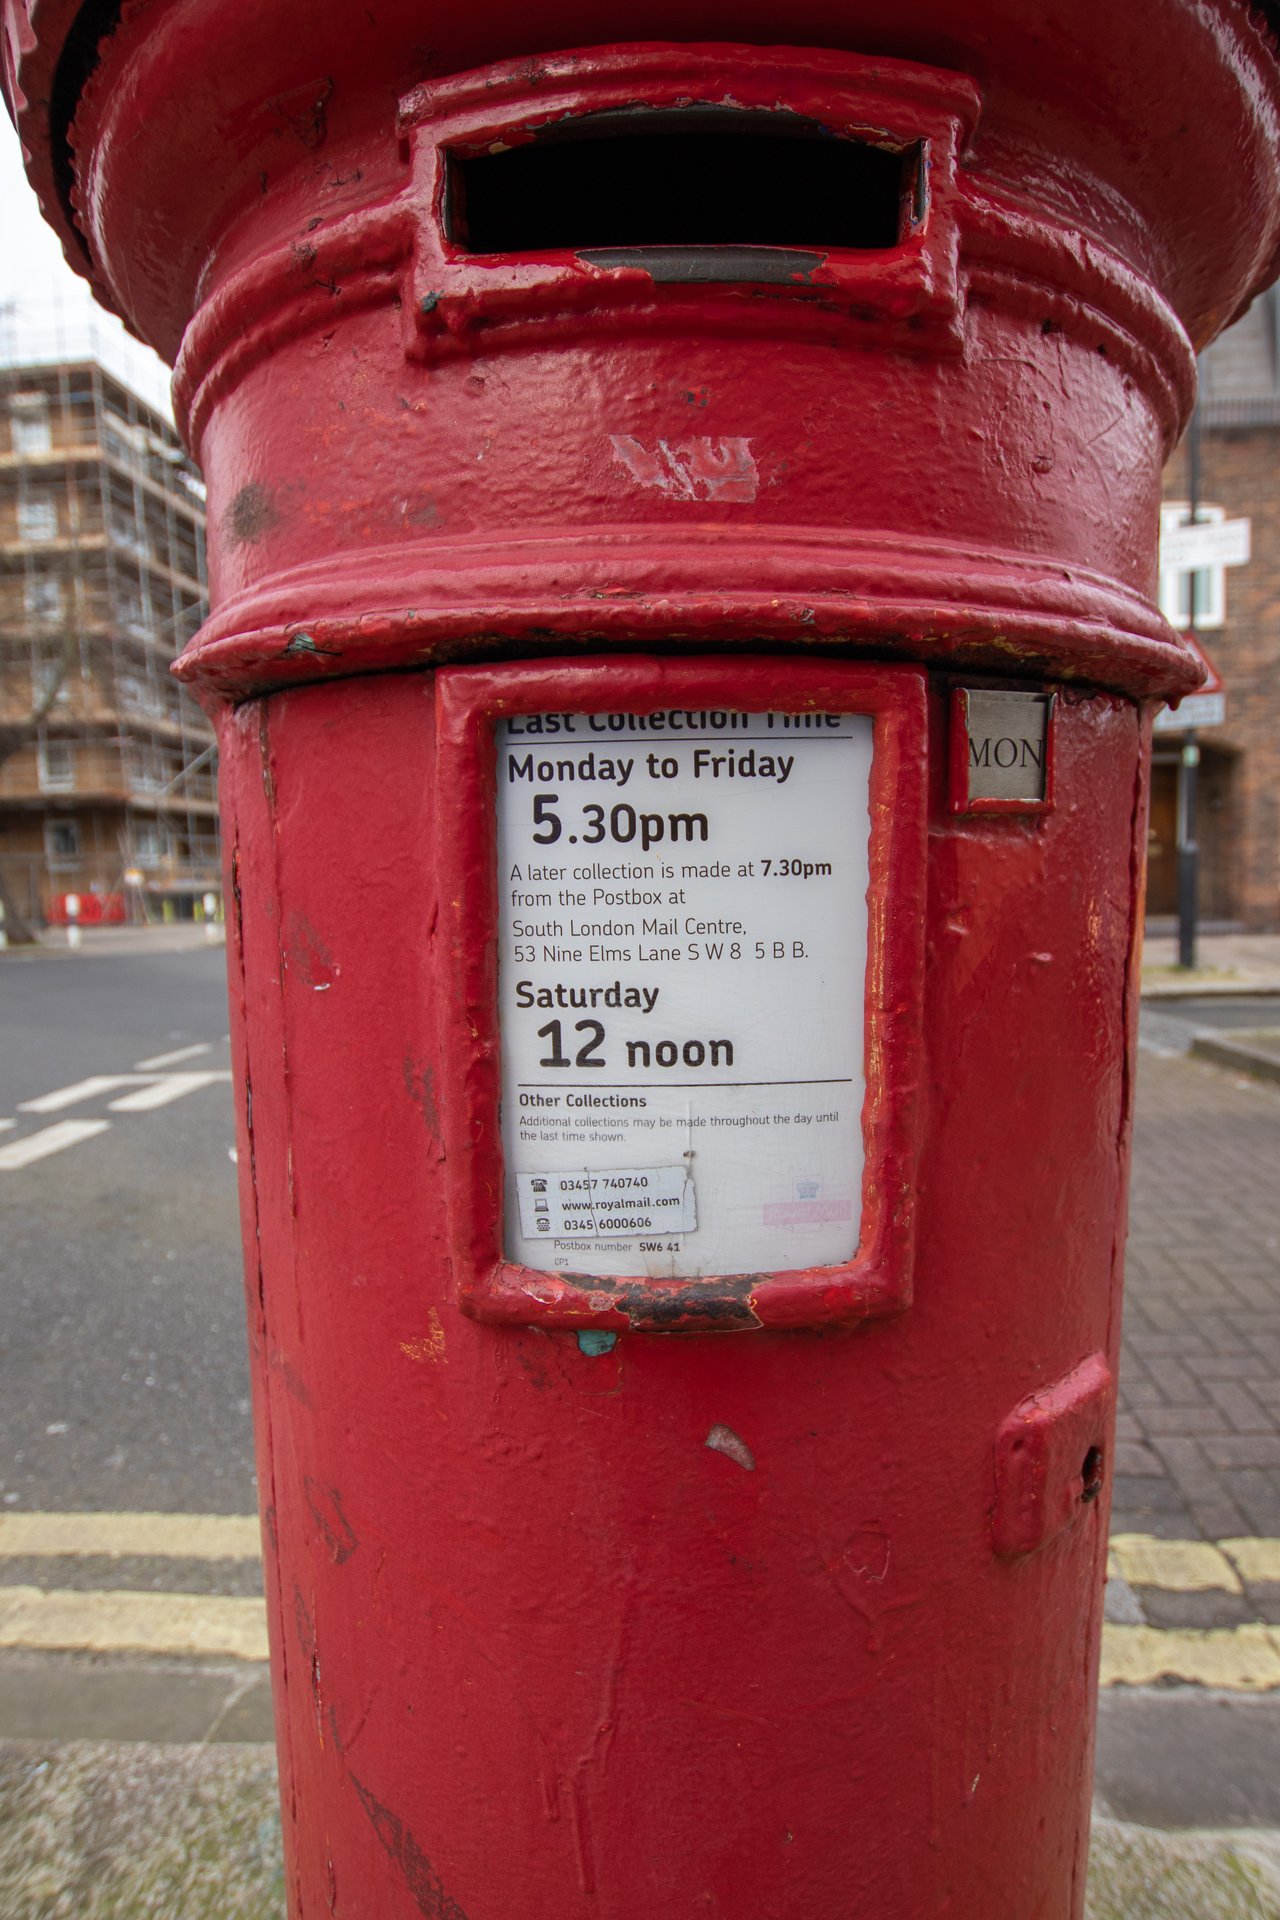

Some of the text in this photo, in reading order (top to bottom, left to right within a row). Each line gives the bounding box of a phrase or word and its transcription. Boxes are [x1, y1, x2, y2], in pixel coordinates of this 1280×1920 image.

[968, 737, 1042, 768] MON
[508, 748, 795, 787] Monday to Friday
[532, 793, 709, 852] 5.30pm
[510, 858, 832, 882] A later collection is made at 7.30pm
[511, 888, 686, 907] from the Postbox at
[512, 917, 747, 938] South London Mail Centre,
[514, 945, 536, 963] 53
[543, 945, 583, 962] Nine
[589, 944, 632, 962] Elms
[638, 944, 681, 962] Lane
[515, 980, 660, 1014] Saturday
[537, 1018, 734, 1068] 12 noon
[519, 1093, 647, 1108] Other Collections
[519, 1111, 839, 1130] Additional collections may be made throughout the day until
[519, 1130, 626, 1142] the last time shown.
[560, 1176, 649, 1192] 03457 740740
[561, 1194, 680, 1213] www.royalmail.com
[563, 1216, 652, 1231] 0345 6000606
[553, 1239, 681, 1252] Postbox number SW6 41
